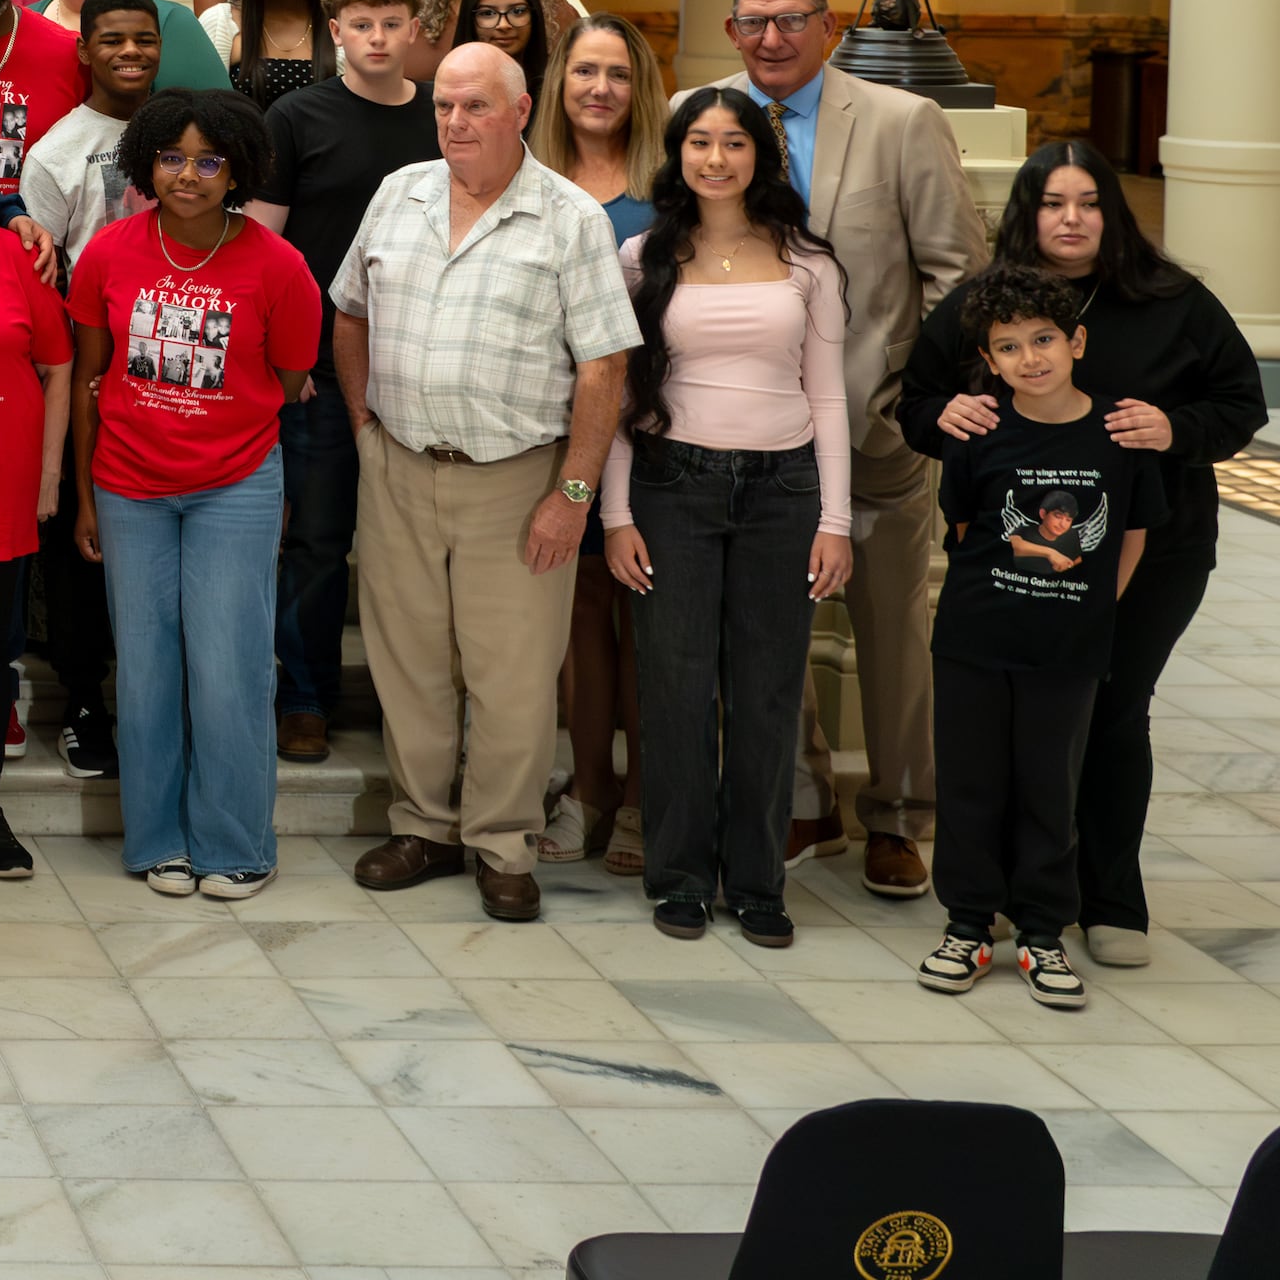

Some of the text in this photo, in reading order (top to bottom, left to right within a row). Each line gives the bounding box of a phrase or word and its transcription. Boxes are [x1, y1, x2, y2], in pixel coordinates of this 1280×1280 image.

[156, 275, 223, 301] In Loving
[137, 288, 238, 314] MEMORY
[178, 405, 208, 418] forgotten
[1016, 468, 1034, 476] Your
[1035, 469, 1058, 478] wings
[1059, 469, 1078, 477] were
[1036, 477, 1060, 485] hearts
[1062, 478, 1080, 486] were
[991, 567, 1089, 591] Christian Gabriel Angulo
[861, 1216, 947, 1257] STATE OF GEORGIA
